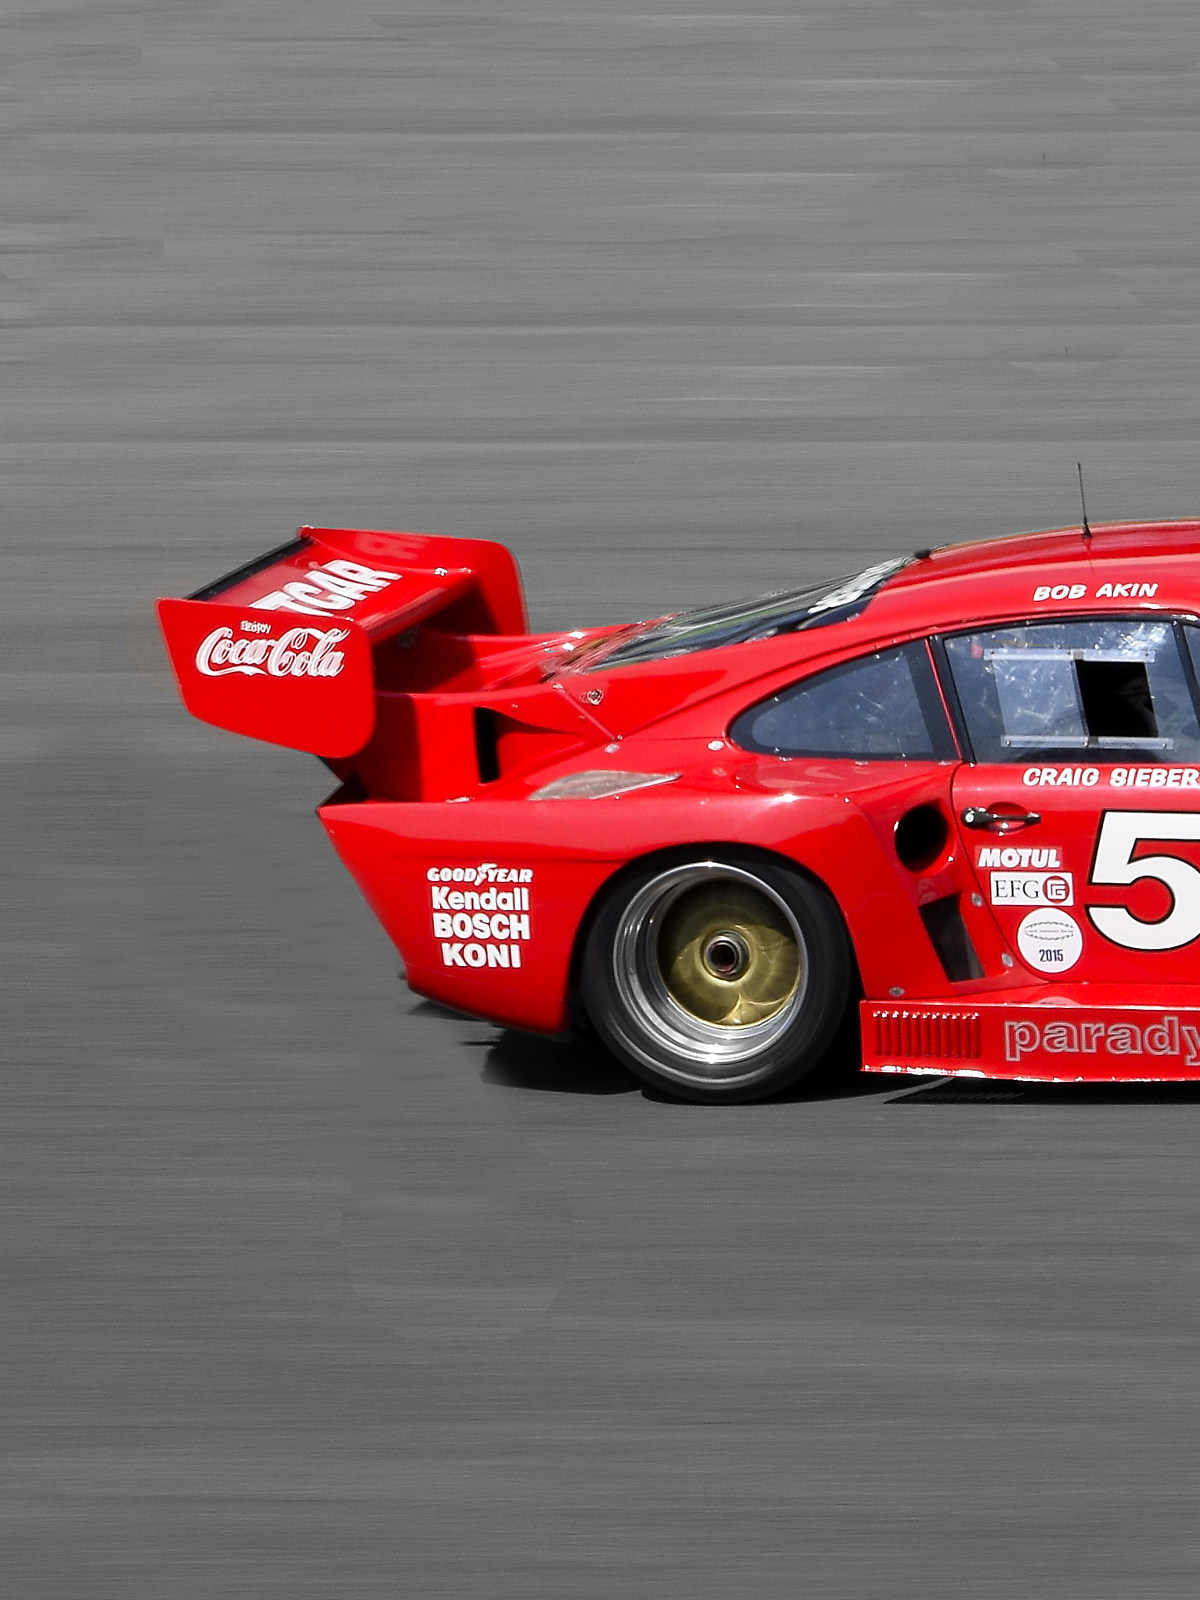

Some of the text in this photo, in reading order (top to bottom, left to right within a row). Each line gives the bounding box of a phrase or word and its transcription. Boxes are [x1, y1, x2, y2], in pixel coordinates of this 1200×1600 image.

[1033, 583, 1158, 601] BOB AKIN
[1022, 767, 1100, 787] CRAIG
[978, 848, 1061, 868] MOTUL
[431, 886, 529, 911] Kendall
[994, 880, 1040, 899] EFG
[432, 913, 531, 940] BOSCH
[441, 943, 521, 968] KONI
[1039, 949, 1063, 962] 2015
